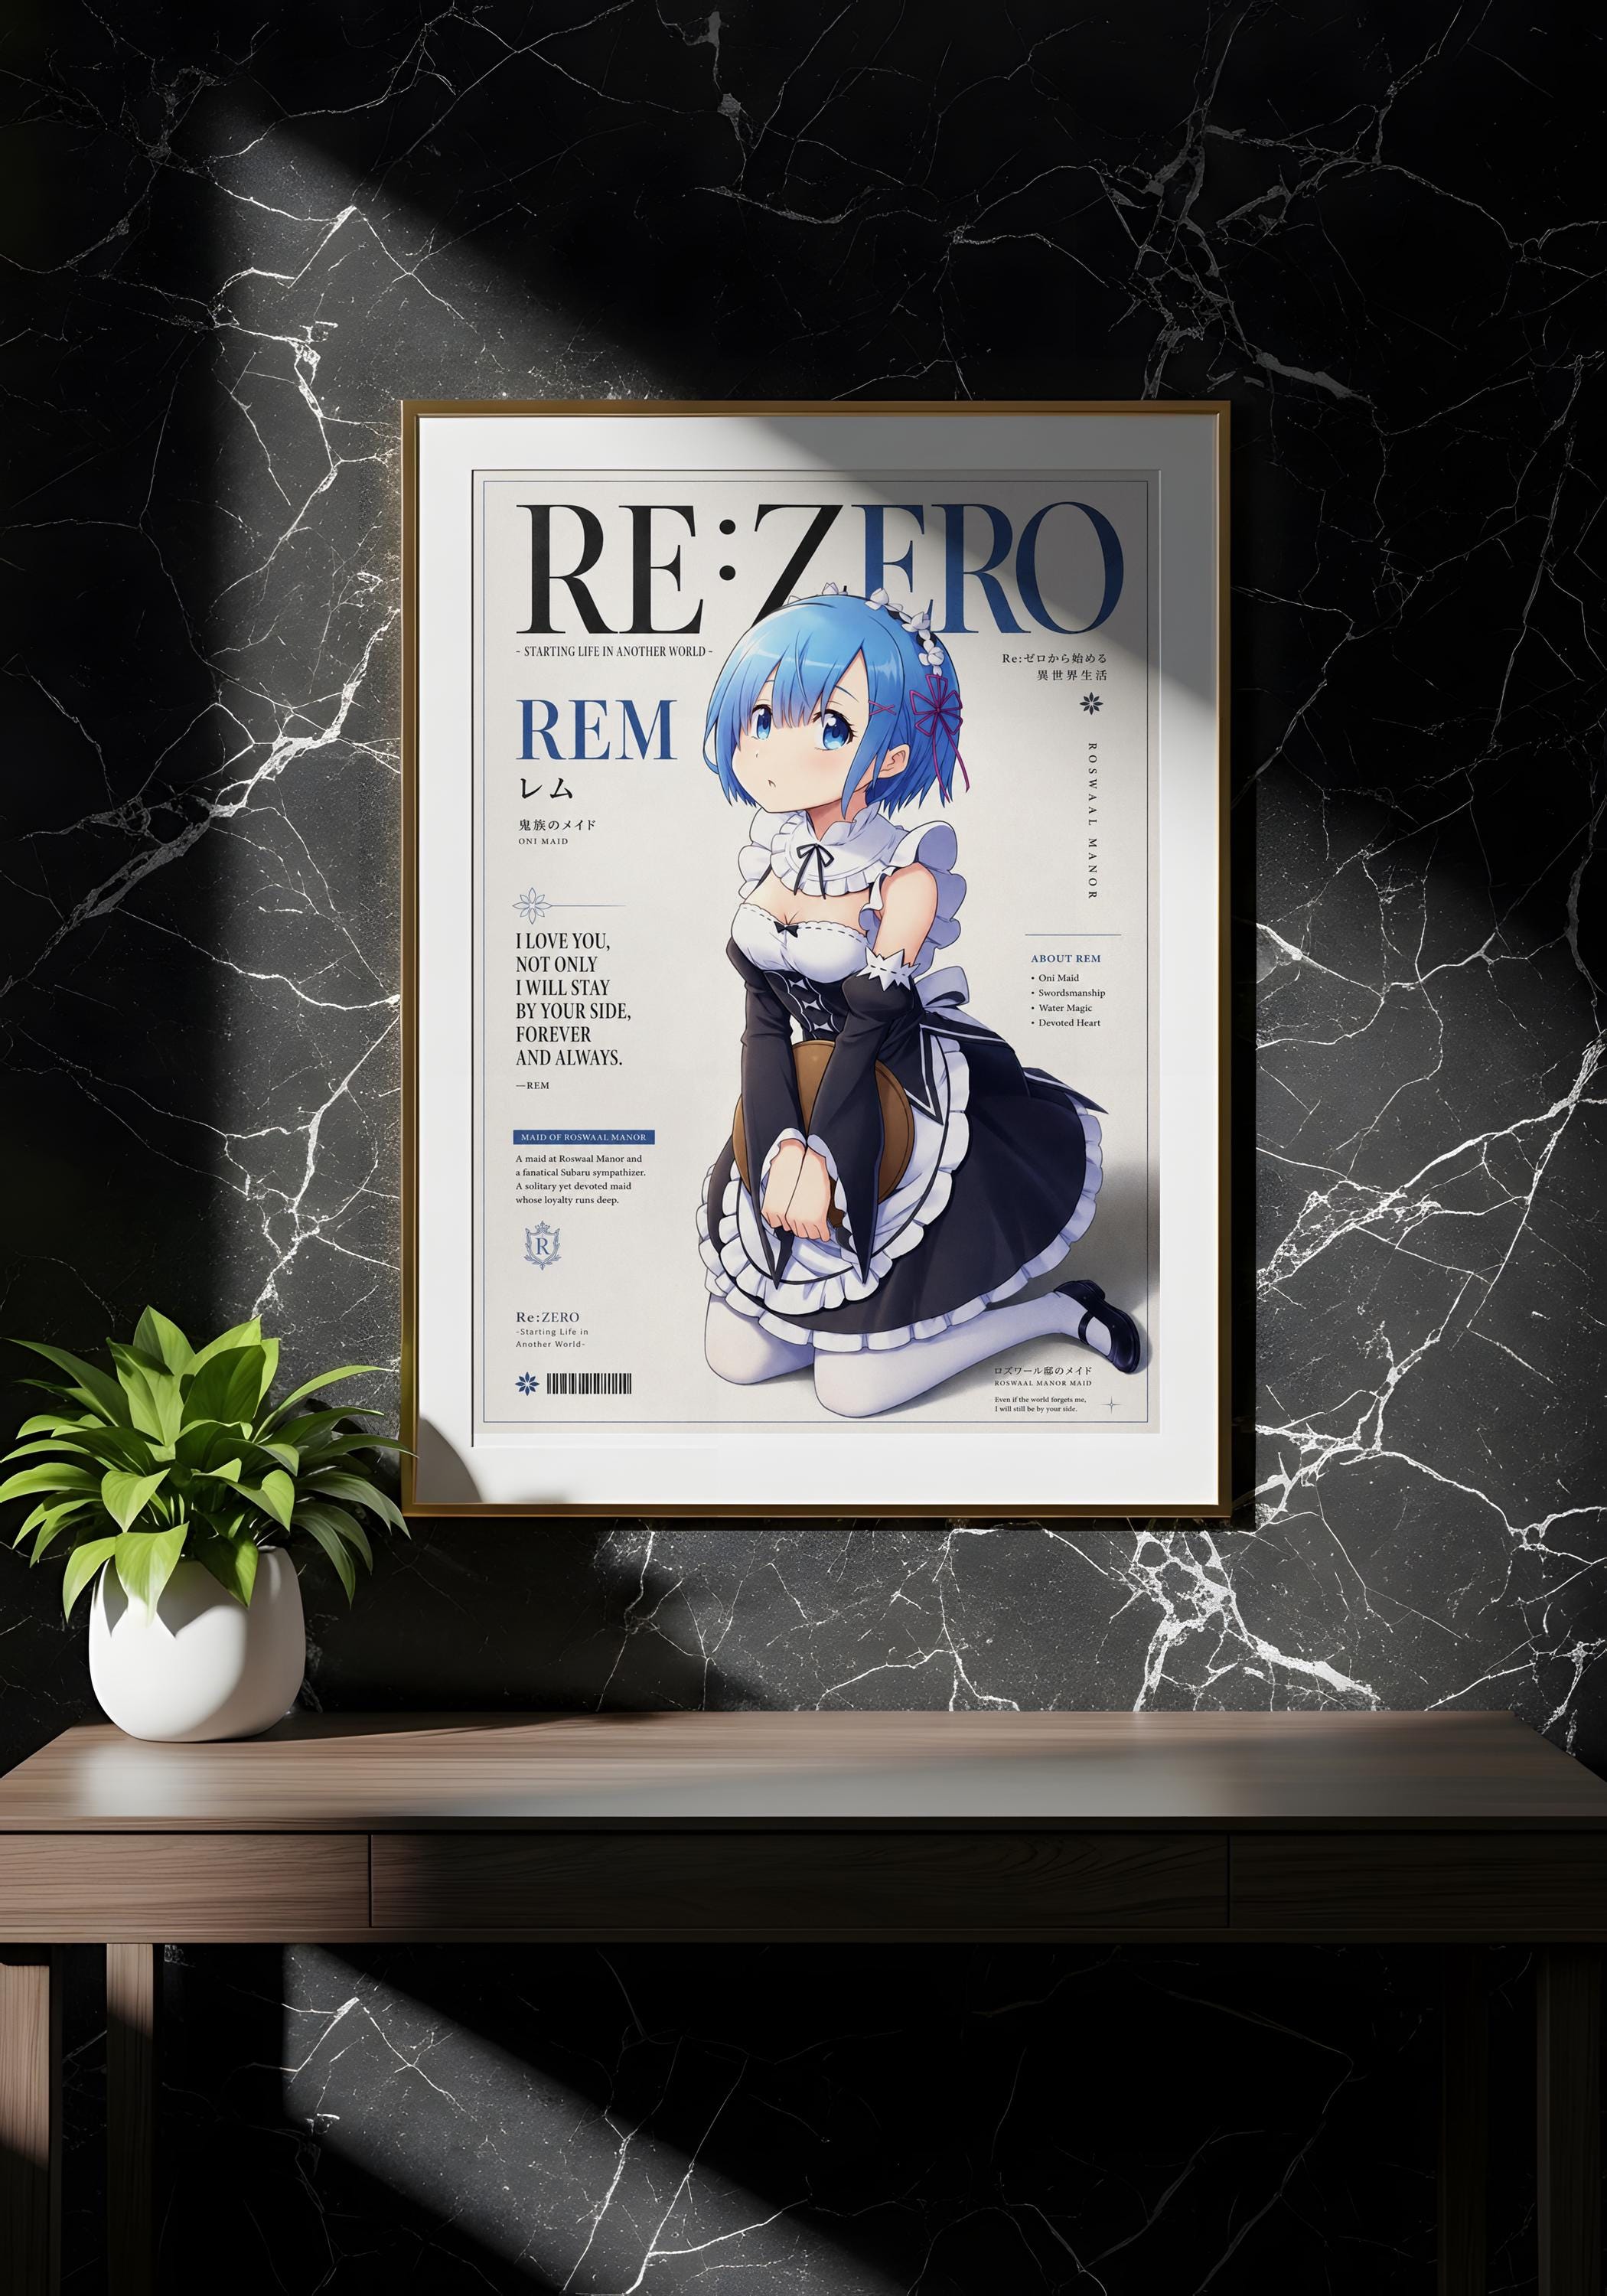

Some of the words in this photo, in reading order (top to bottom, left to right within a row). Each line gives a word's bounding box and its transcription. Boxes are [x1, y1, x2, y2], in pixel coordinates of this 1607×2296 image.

[525, 646, 575, 656] STARTING
[579, 646, 599, 656] LIFE
[603, 647, 613, 656] IN
[617, 646, 666, 656] ANOTHER
[669, 646, 706, 656] WORLD
[1002, 653, 1107, 664] Re:ゼロから始める
[1038, 670, 1107, 680] 異世界生活
[516, 700, 677, 760] REM
[520, 778, 572, 799] レム
[520, 819, 595, 830] 鬼族のメイド
[517, 933, 520, 948] I
[526, 933, 568, 949] LOVE
[572, 933, 610, 951] YOU,
[517, 957, 550, 972] NOT
[555, 957, 598, 972] ONLY
[517, 980, 520, 995] I
[526, 980, 567, 995] WILL
[572, 980, 610, 996] STAY
[1039, 989, 1105, 998] Swordsmanship
[517, 1003, 536, 1019] BY
[540, 1003, 585, 1019] YOUR
[591, 1003, 631, 1021] SIDE,
[1067, 1005, 1092, 1013] Magic
[517, 1026, 591, 1042] FOREVER
[517, 1050, 551, 1065] AND
[556, 1049, 622, 1065] ALWAYS.
[593, 1169, 645, 1178] sympathizer.
[526, 1182, 556, 1192] solitary
[545, 1196, 572, 1205] loyalty
[597, 1196, 618, 1205] deep.
[536, 1238, 550, 1255] R
[517, 1313, 579, 1322] Re:ZERO
[995, 1366, 1092, 1375] ロズワール邸のメイド
